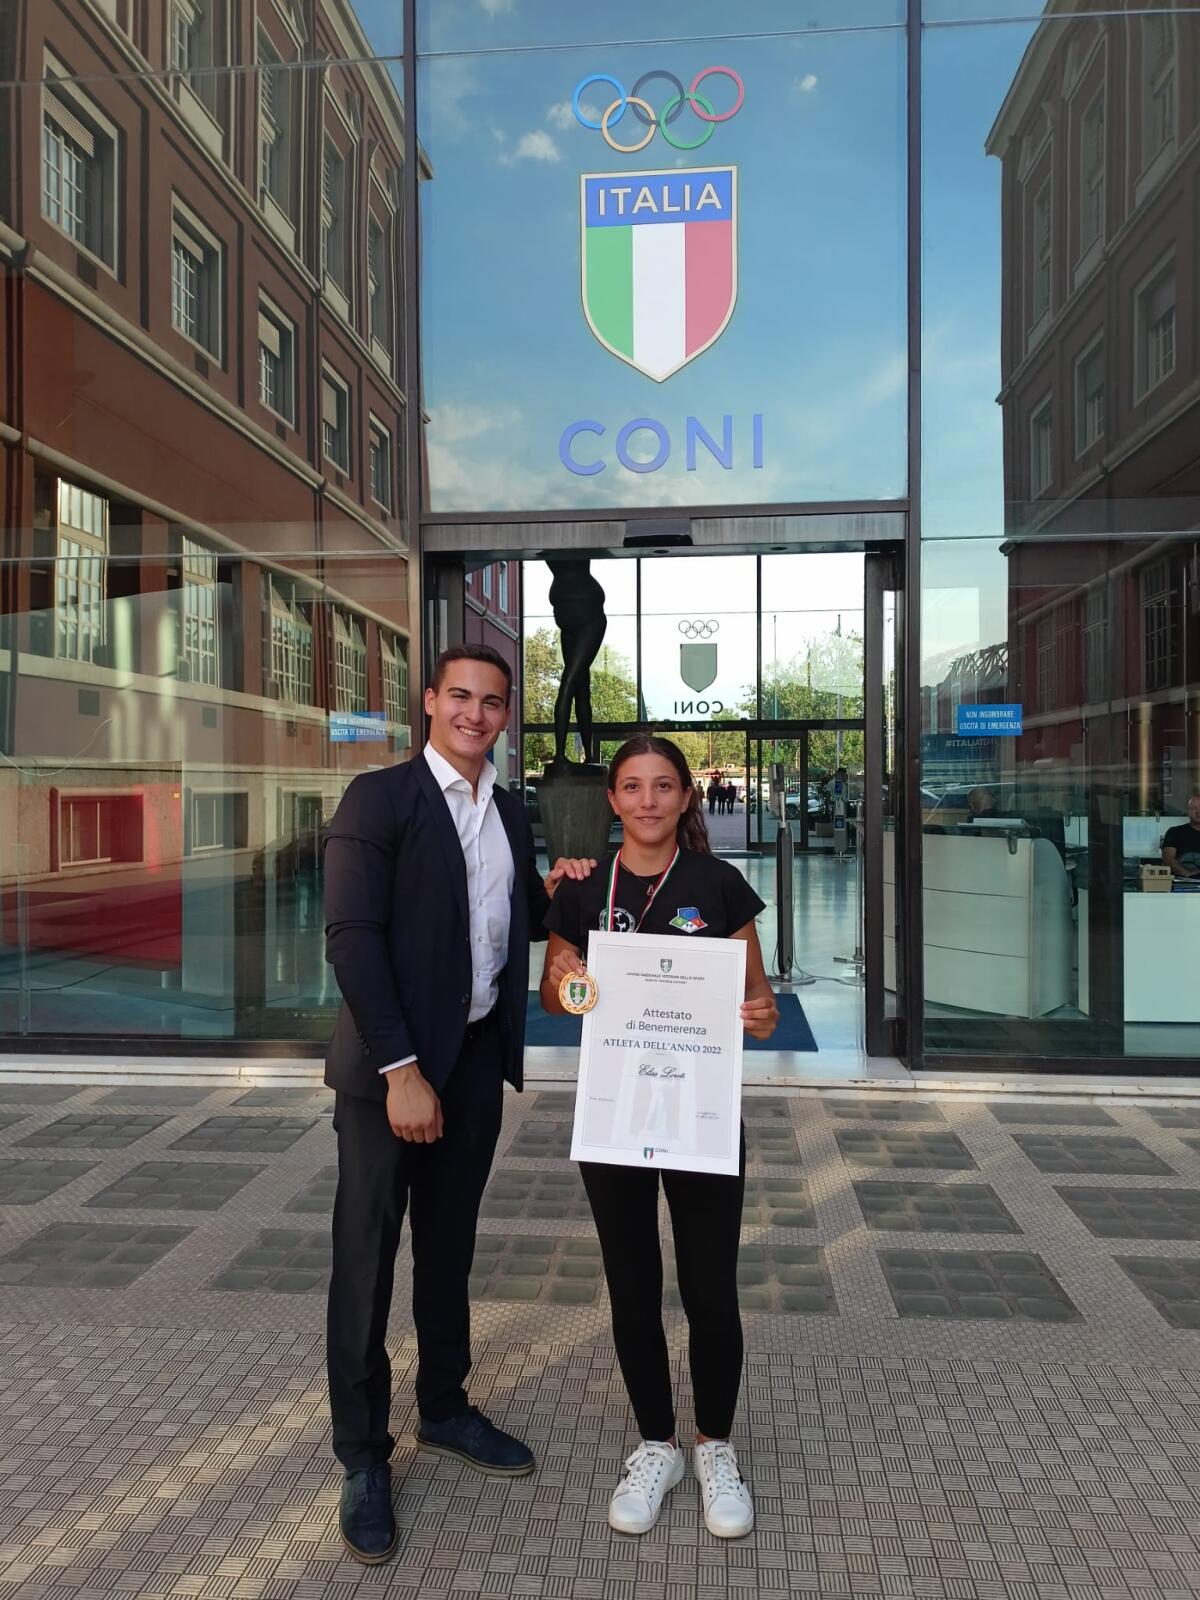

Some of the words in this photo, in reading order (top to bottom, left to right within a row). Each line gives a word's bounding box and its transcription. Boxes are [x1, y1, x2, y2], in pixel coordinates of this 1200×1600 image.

[599, 183, 722, 216] ITALIA
[558, 414, 764, 476] CONI
[966, 711, 977, 719] NON
[959, 722, 979, 730] USCITA
[988, 721, 1021, 730] EMERGENZA
[643, 1008, 692, 1021] Attestato
[626, 1020, 636, 1030] di
[638, 1021, 707, 1035] Benemerenza
[603, 1038, 640, 1048] ATLETA
[643, 1041, 700, 1053] DELL'ANNO
[702, 1045, 722, 1054] 2022
